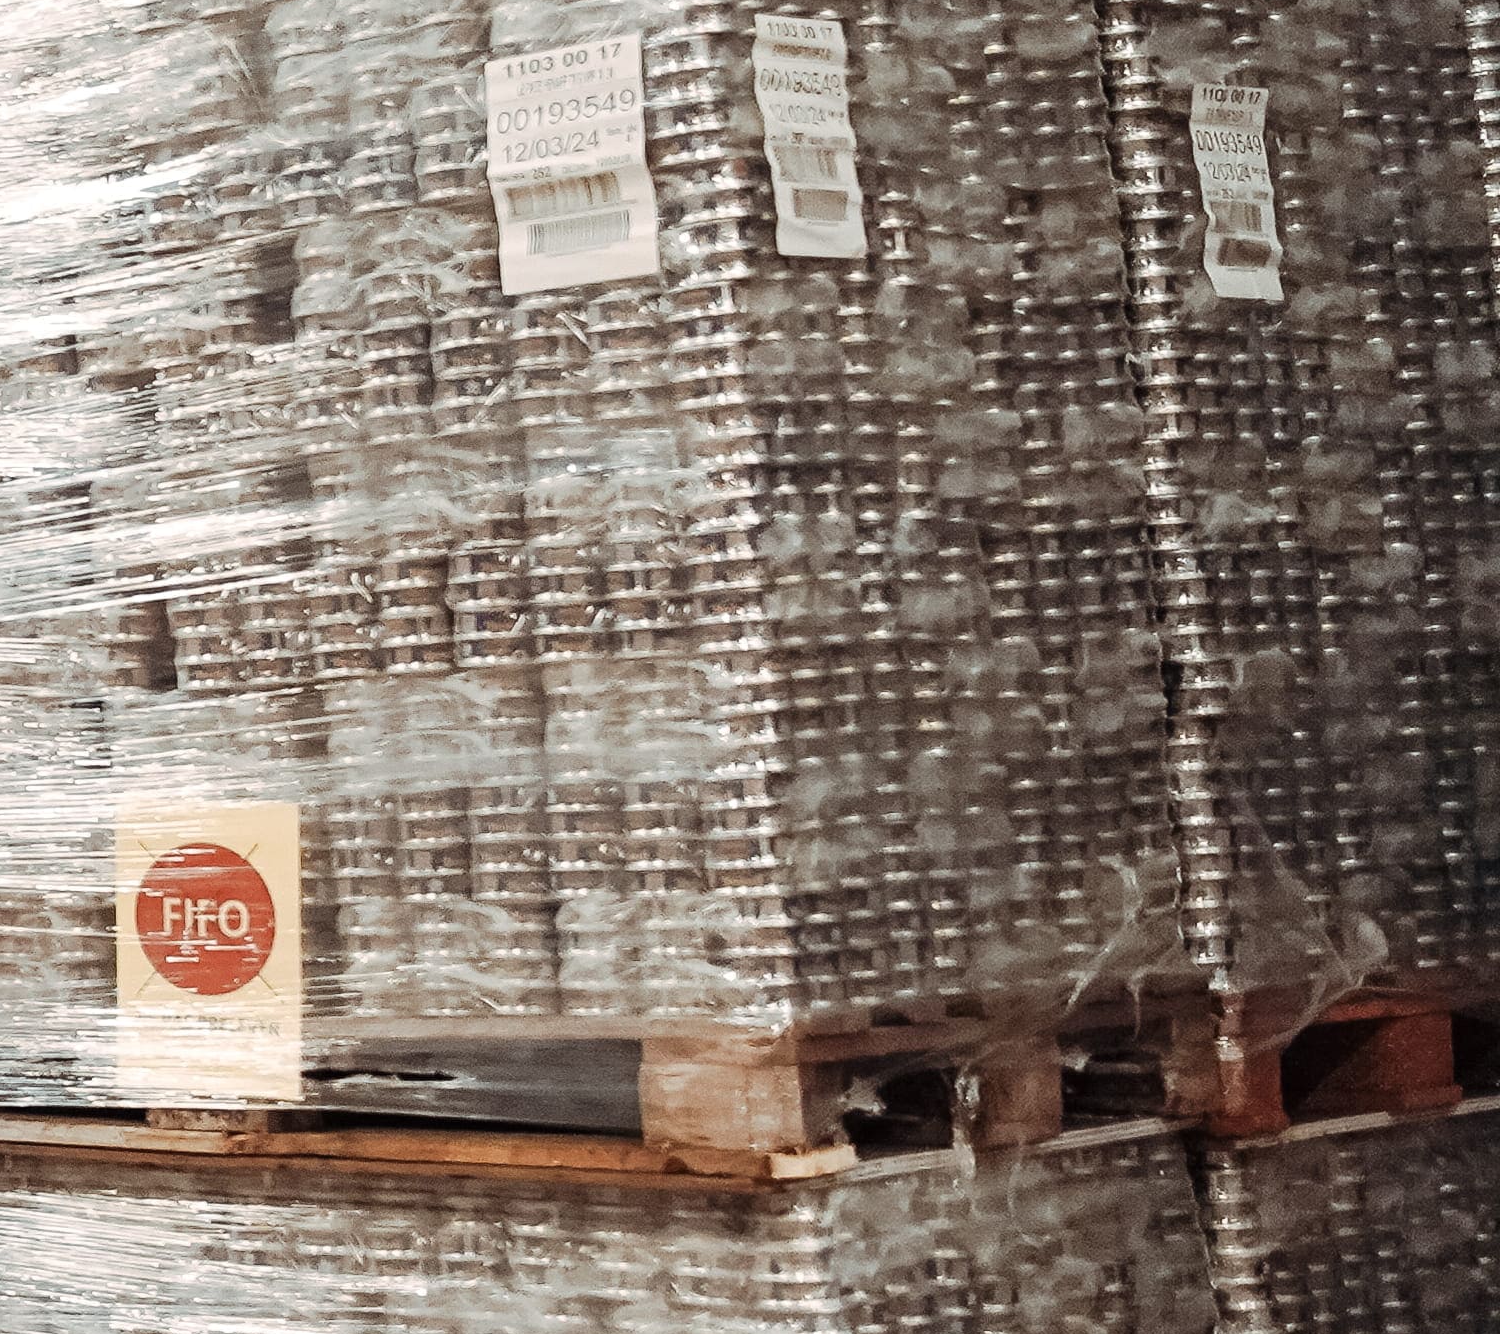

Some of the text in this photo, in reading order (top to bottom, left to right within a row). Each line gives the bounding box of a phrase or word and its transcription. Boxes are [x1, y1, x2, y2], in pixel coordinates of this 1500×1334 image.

[505, 42, 622, 79] 1103 00 17
[497, 89, 636, 135] 00193549
[1249, 90, 1261, 105] 17
[503, 130, 600, 164] 12/03/24
[1195, 130, 1262, 155] 00193549
